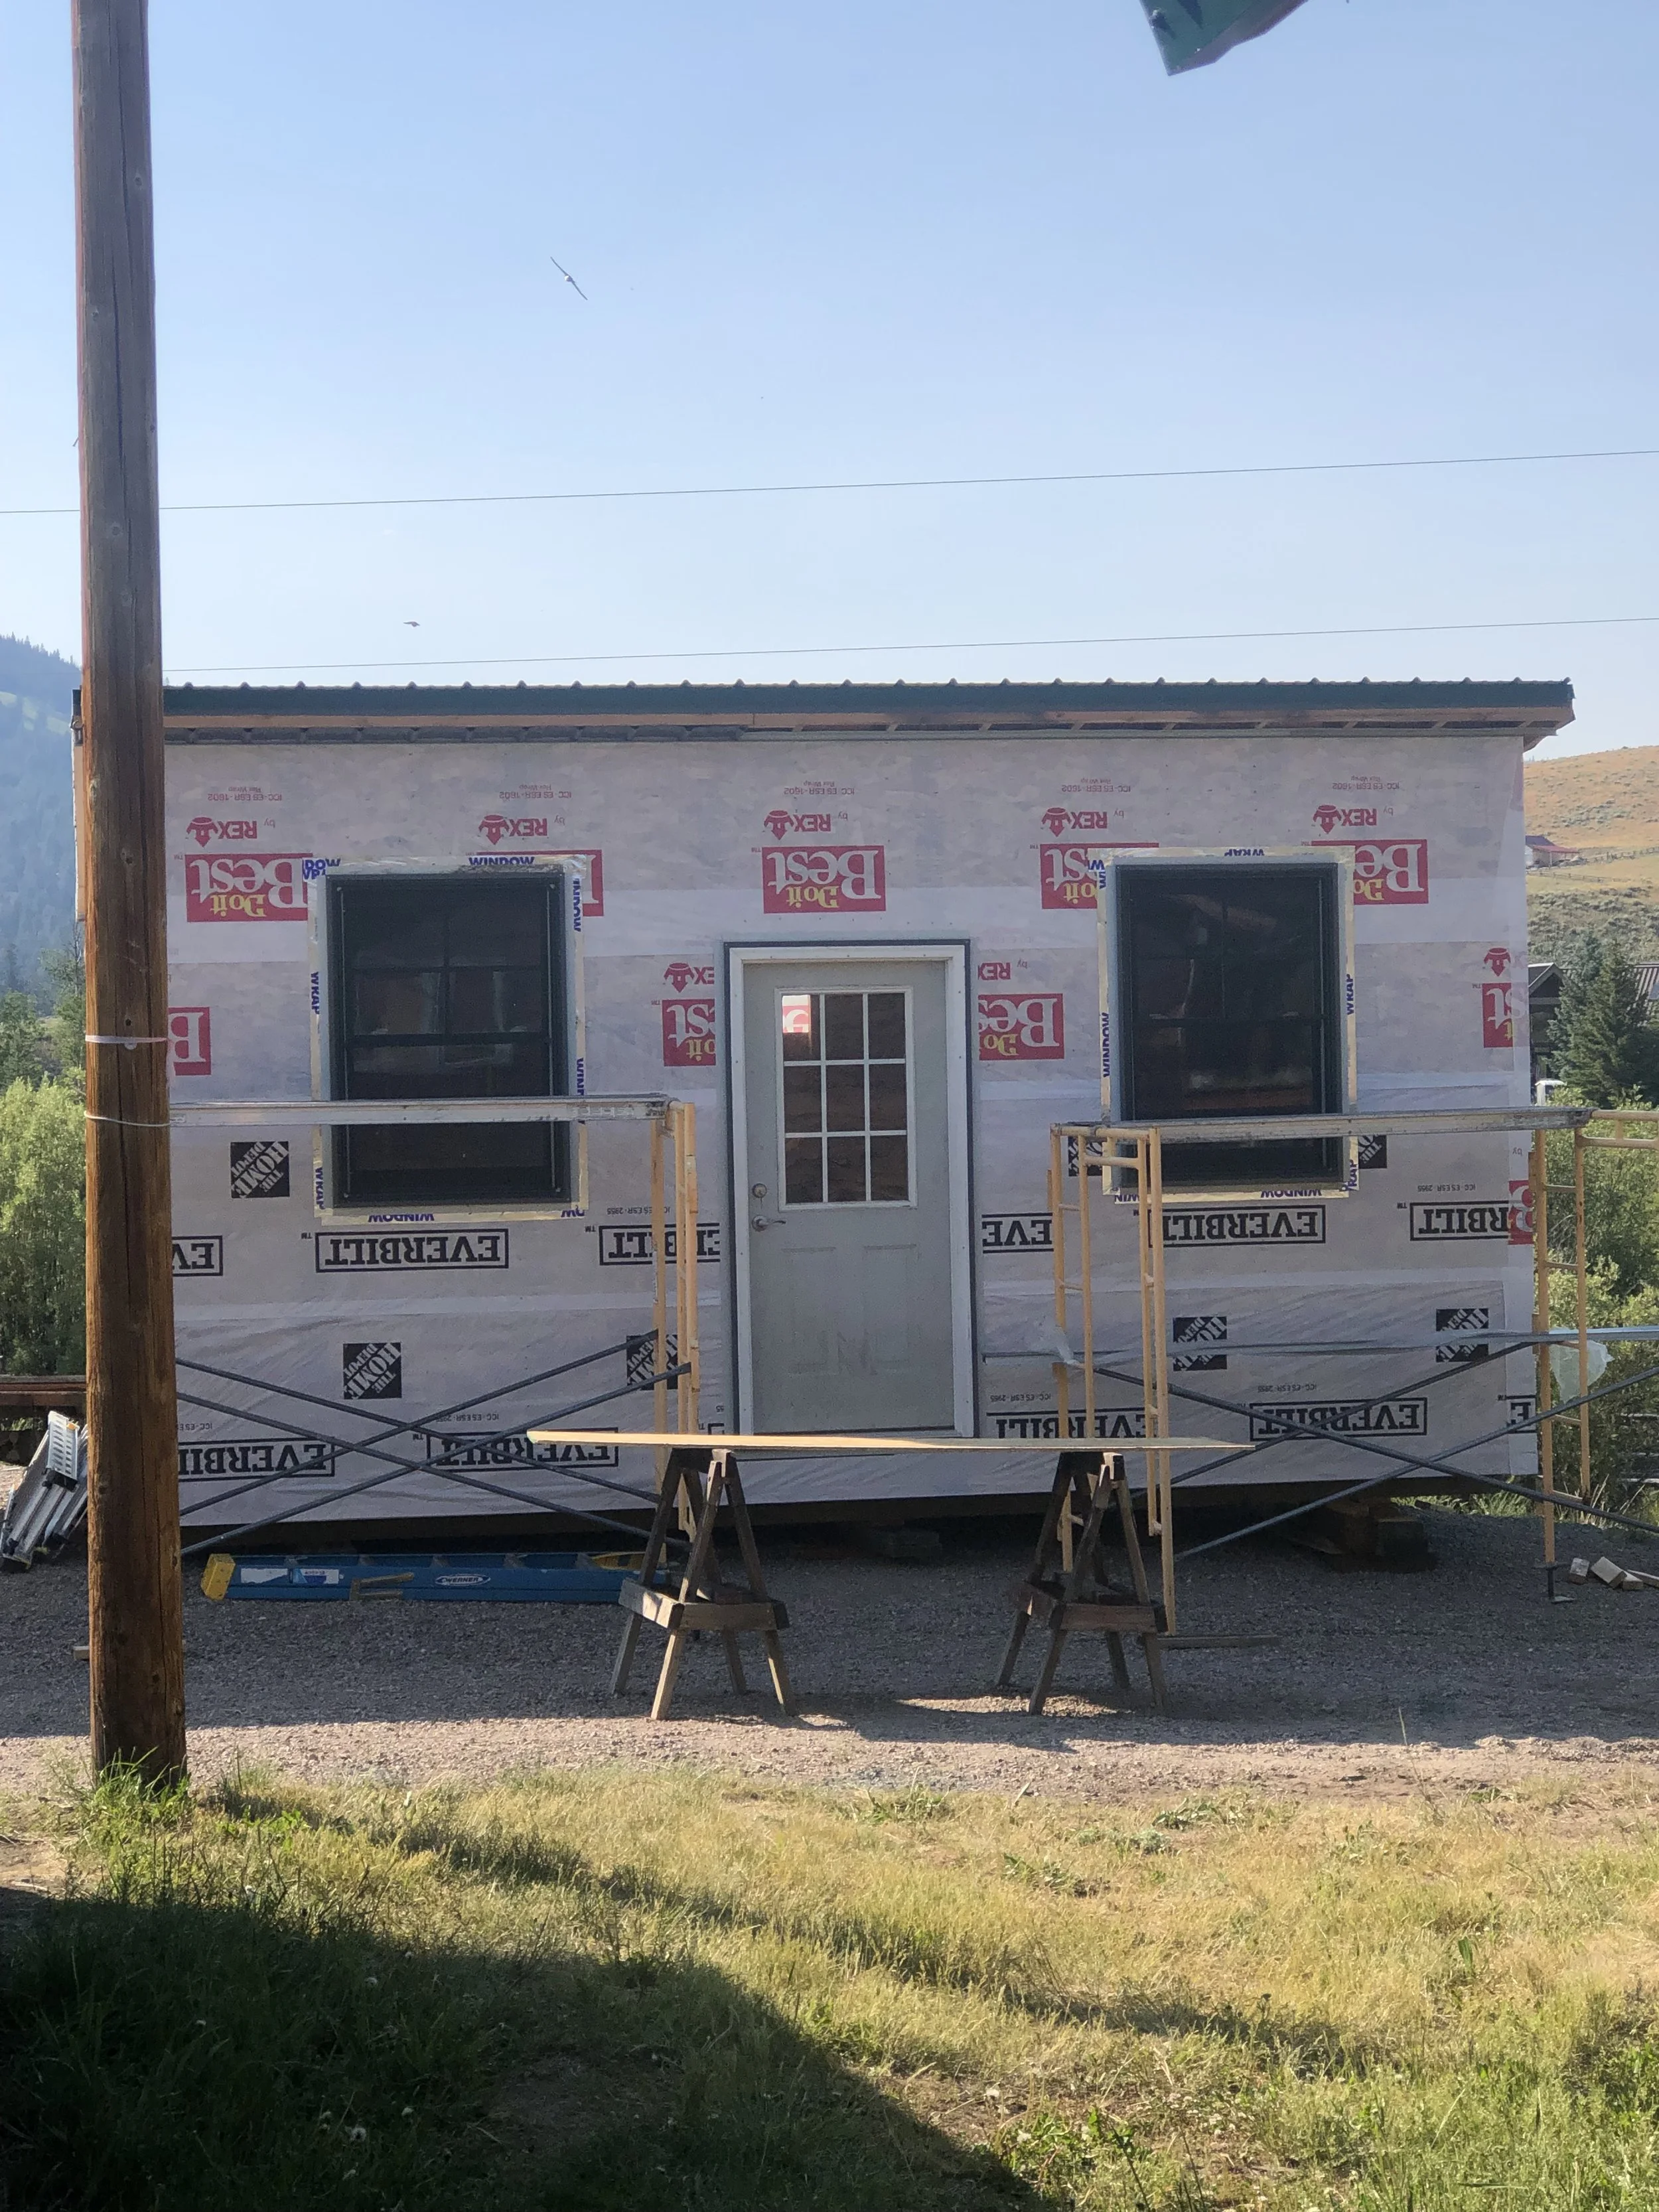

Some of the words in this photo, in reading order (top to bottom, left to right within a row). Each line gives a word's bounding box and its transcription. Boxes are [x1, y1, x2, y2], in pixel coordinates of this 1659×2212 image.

[554, 815, 565, 826] by
[837, 811, 849, 820] by
[1070, 811, 1108, 830] REX
[1114, 808, 1124, 818] by
[1340, 808, 1378, 826] REX
[1383, 806, 1394, 816] by
[218, 820, 257, 840] REX
[263, 818, 276, 828] by
[509, 818, 548, 837] REX
[793, 814, 831, 832] REX
[468, 856, 536, 866] WINDOW
[1354, 844, 1424, 892] Be
[189, 858, 308, 909] Best
[766, 850, 882, 899] Best
[786, 885, 802, 909] it
[804, 885, 840, 909] Do
[1063, 883, 1078, 904] it
[210, 894, 227, 917] it
[229, 894, 267, 917] Do
[693, 966, 715, 985] EX
[1017, 958, 1028, 970] by
[685, 1039, 702, 1062] it
[983, 1033, 1019, 1056] Do
[230, 1141, 267, 1178] DEPOT
[231, 1141, 289, 1199] HOME
[259, 1169, 284, 1193] THE
[324, 1235, 501, 1266] EVERBILT
[342, 1342, 401, 1400] HOME
[343, 1343, 379, 1380] DEPOT
[372, 1370, 397, 1394] THE
